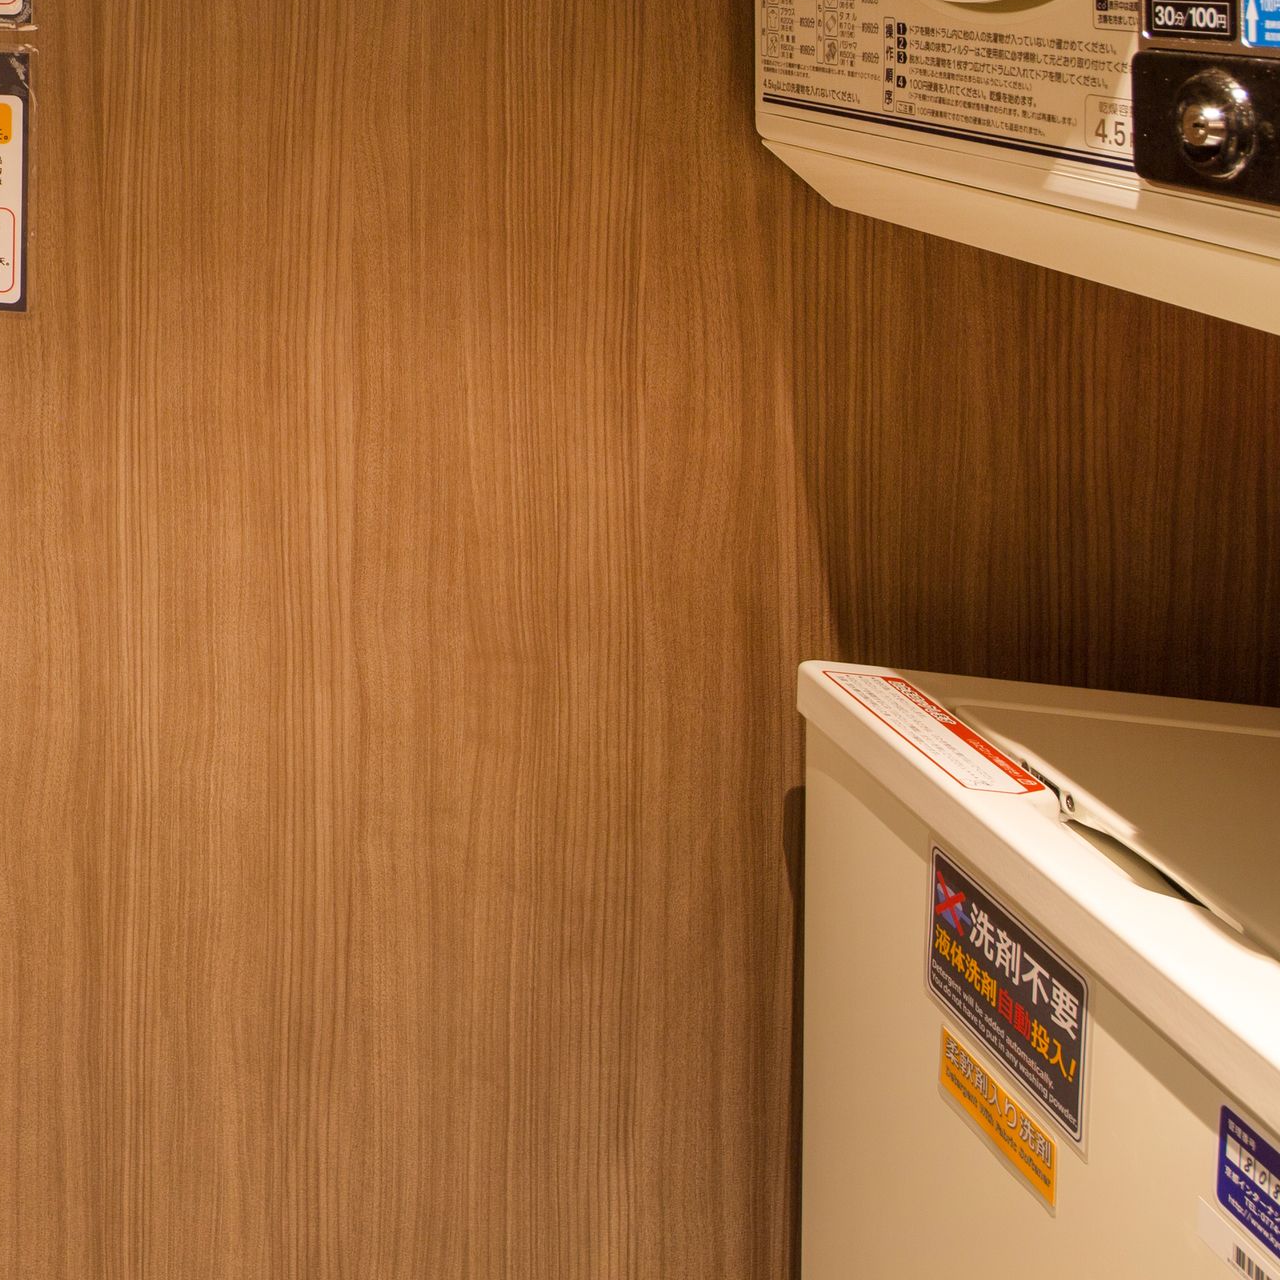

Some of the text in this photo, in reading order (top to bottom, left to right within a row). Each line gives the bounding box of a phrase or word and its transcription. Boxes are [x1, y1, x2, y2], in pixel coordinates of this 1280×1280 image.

[1155, 6, 1226, 29] 30分/100円
[1094, 118, 1126, 147] 4.5
[932, 959, 961, 995] Detergent
[963, 992, 974, 1008] will
[975, 1002, 983, 1017] be
[984, 1014, 1004, 1038] added
[932, 970, 942, 989] You
[943, 985, 951, 997] do
[952, 994, 962, 1009] not
[963, 1003, 978, 1025] have
[979, 1020, 985, 1032] to
[986, 1029, 997, 1046] put
[998, 1043, 1005, 1052] in
[1005, 1051, 1018, 1067] any
[1019, 1063, 1048, 1099] washing
[935, 923, 1076, 1083] 液体洗剤自動投入!
[968, 901, 1079, 1040] 洗剤不要
[946, 1038, 1051, 1168] 柔軟剤入り洗剤
